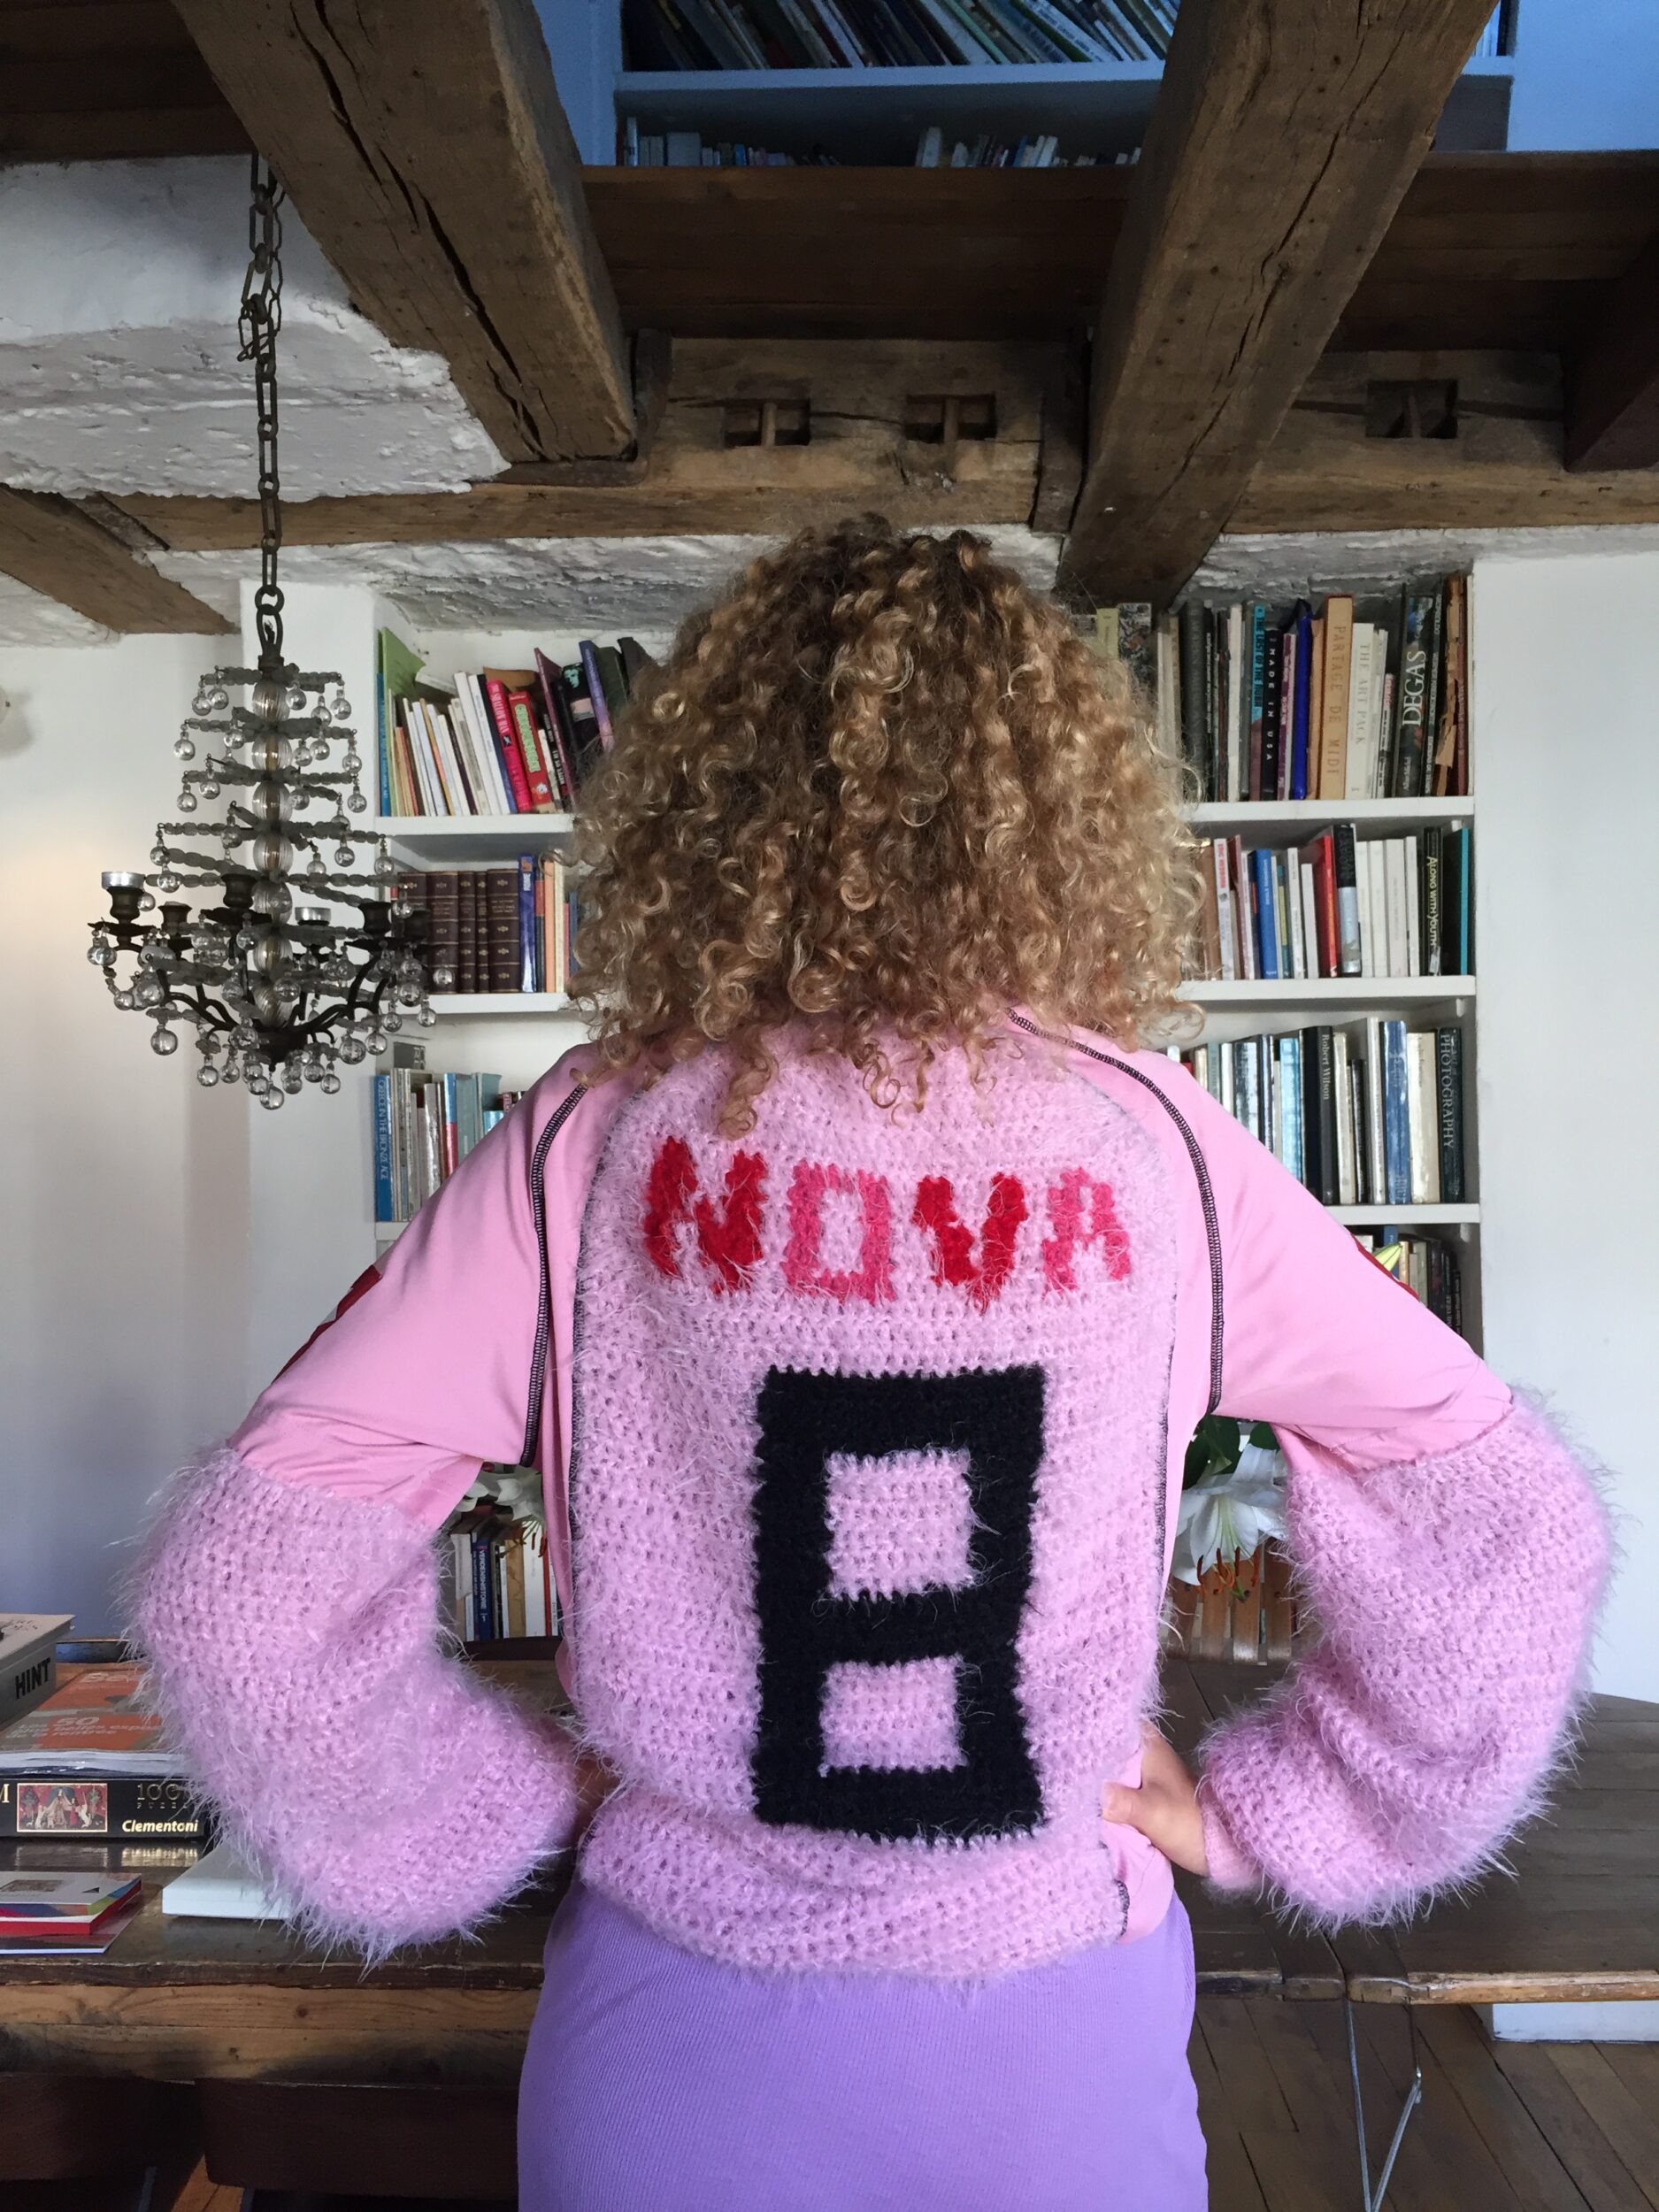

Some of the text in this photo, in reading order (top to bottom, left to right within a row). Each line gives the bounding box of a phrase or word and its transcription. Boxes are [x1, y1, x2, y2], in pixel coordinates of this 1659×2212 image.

[1256, 634, 1264, 654] LAST
[1359, 643, 1371, 672] THE
[1327, 625, 1346, 774] PARTAGE DE MIDI
[1357, 680, 1369, 704] ART
[1402, 649, 1427, 727] DEGAS
[1267, 702, 1275, 718] IN
[1356, 710, 1367, 745] PACK
[1426, 856, 1438, 888] ALONG
[1426, 914, 1439, 948] YOUTH
[1321, 1033, 1331, 1100] Robert Wilson
[377, 1079, 386, 1107] GREECE
[1440, 1033, 1455, 1149] PHOTOGRAPHY
[643, 1136, 1132, 1315] NOVA
[753, 1363, 1048, 1846] 8
[15, 1657, 51, 1700] HINT
[53, 1716, 100, 1726] 50
[121, 1819, 199, 1833] Clementoni
